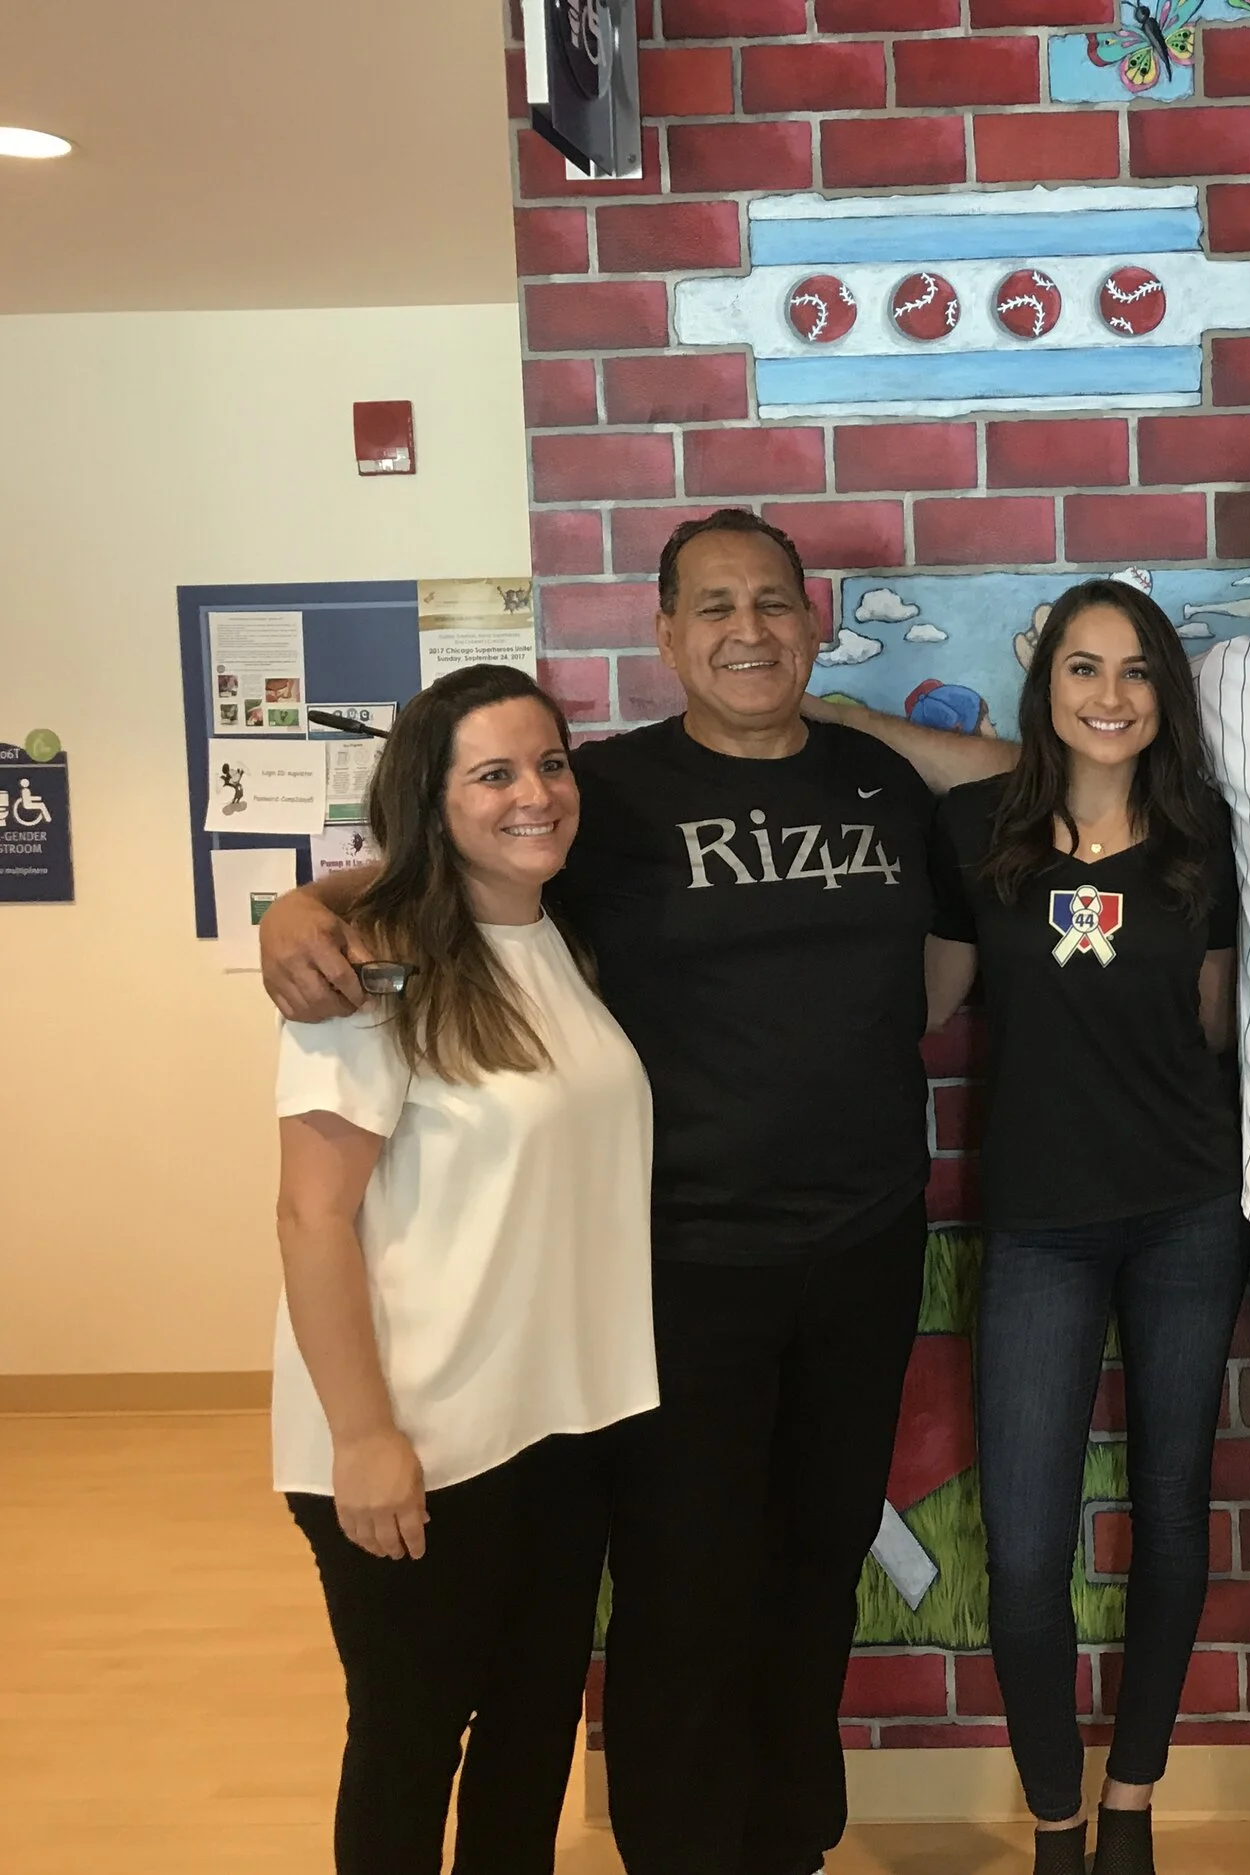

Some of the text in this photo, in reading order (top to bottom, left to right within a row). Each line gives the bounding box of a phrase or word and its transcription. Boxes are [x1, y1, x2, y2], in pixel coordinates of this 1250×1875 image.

[446, 646, 474, 654] Chicago
[475, 645, 514, 653] Superheroes
[465, 654, 498, 662] September
[1075, 913, 1095, 928] 44
